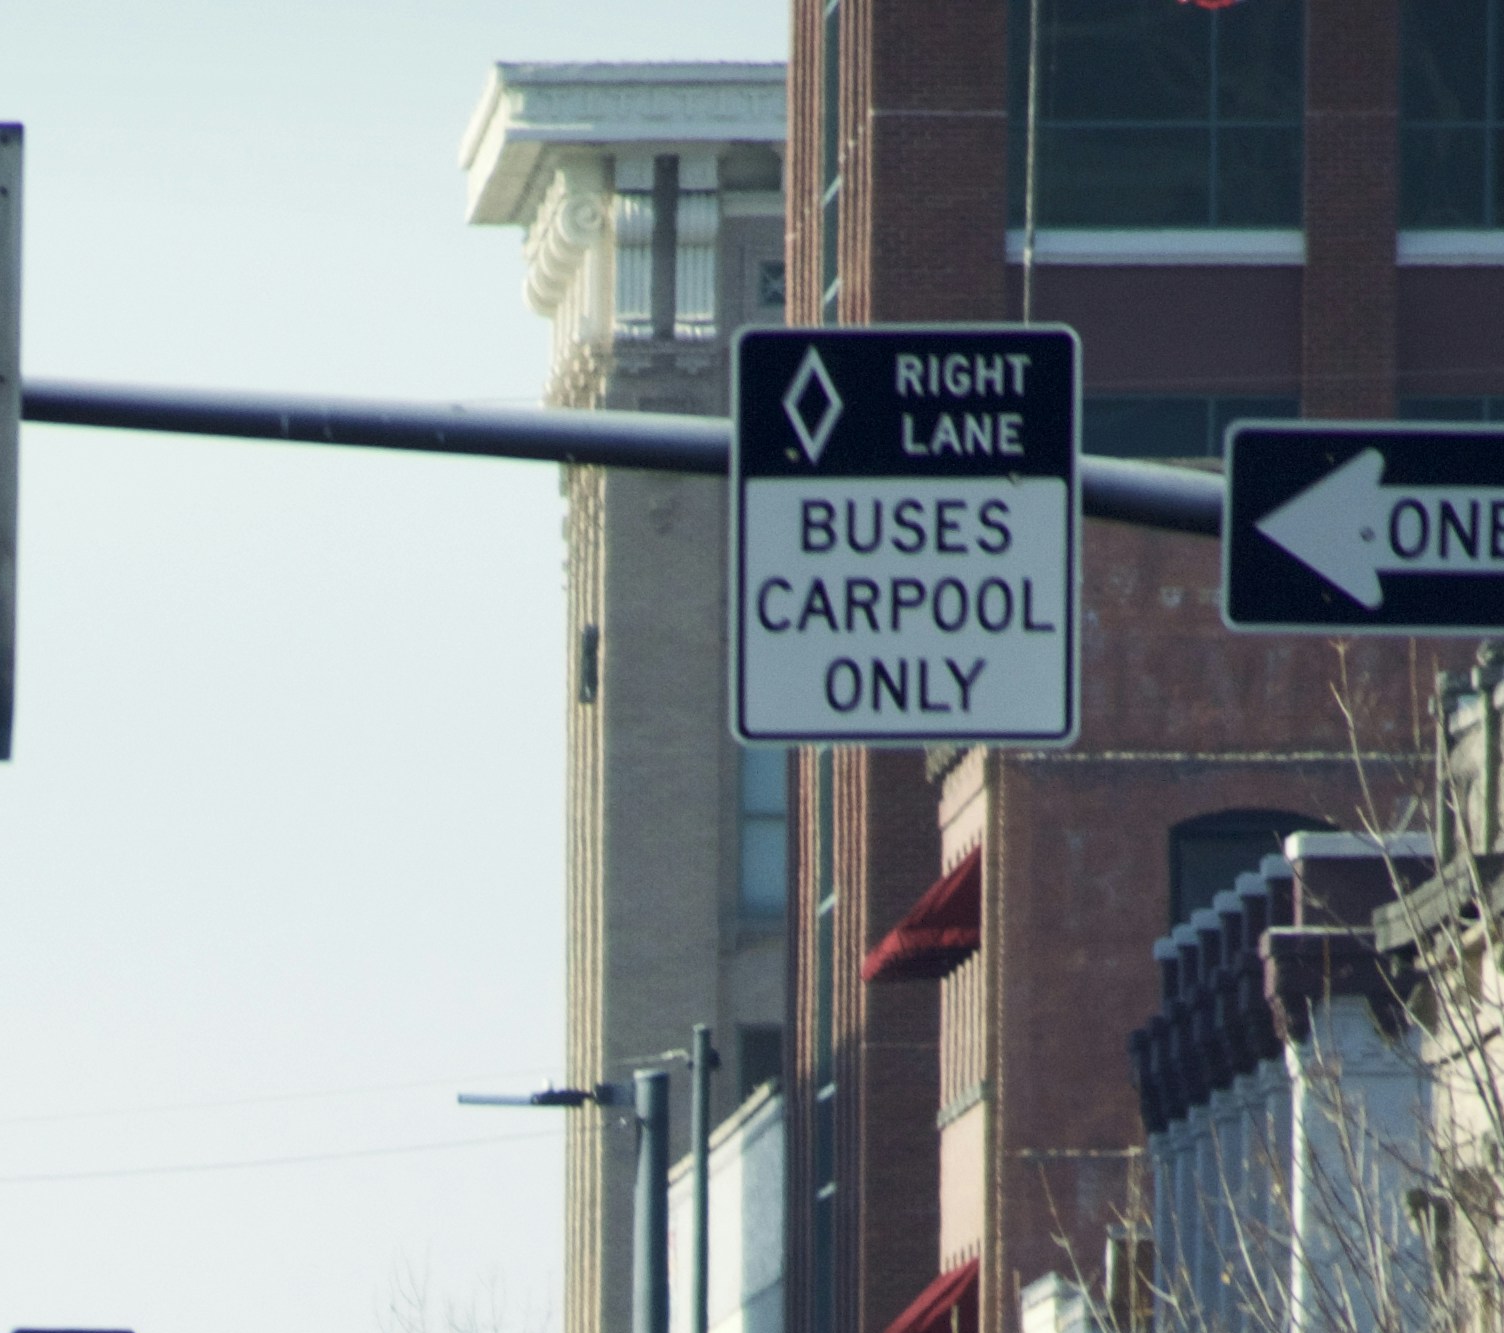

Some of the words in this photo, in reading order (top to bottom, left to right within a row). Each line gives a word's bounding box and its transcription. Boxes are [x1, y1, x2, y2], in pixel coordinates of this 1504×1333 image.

[896, 353, 1031, 397] RIGHT
[901, 412, 1025, 456] LANE
[800, 498, 1013, 554] BUSES
[756, 576, 1056, 633] CARPOOL
[824, 656, 987, 714] ONLY
